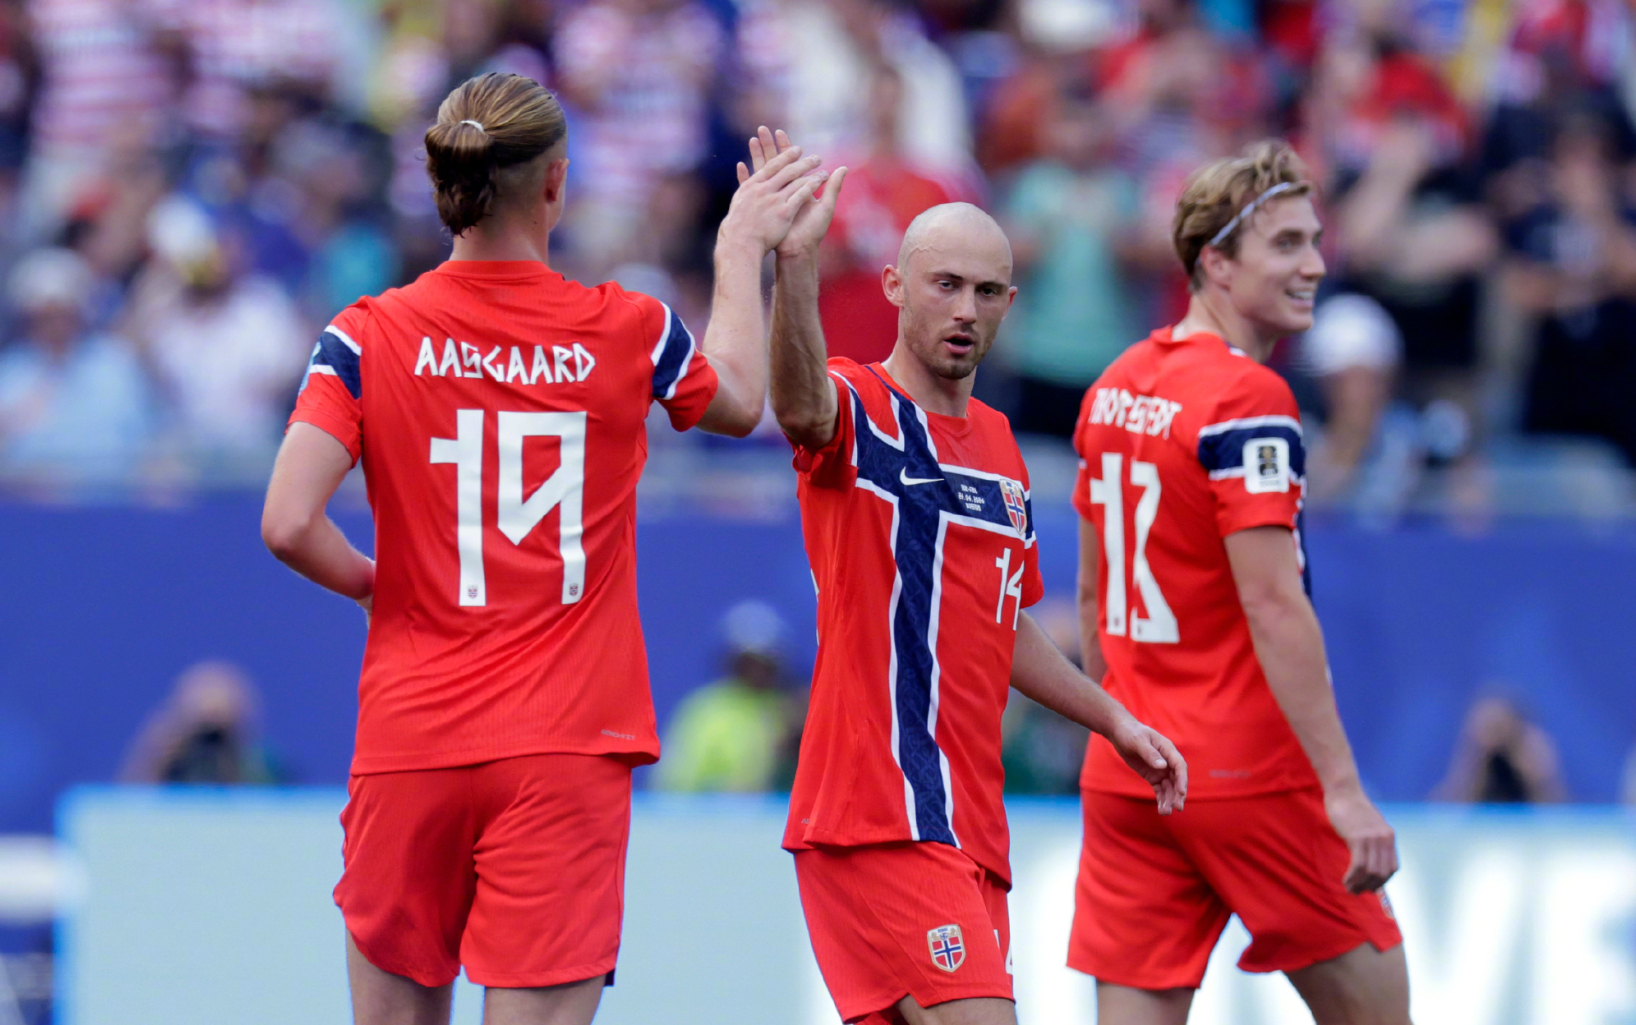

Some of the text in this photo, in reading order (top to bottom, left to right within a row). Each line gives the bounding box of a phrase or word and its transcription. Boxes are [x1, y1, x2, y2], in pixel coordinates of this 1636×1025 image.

[414, 336, 596, 385] AASGAARD
[430, 409, 587, 607] 19
[995, 547, 1025, 631] 14
